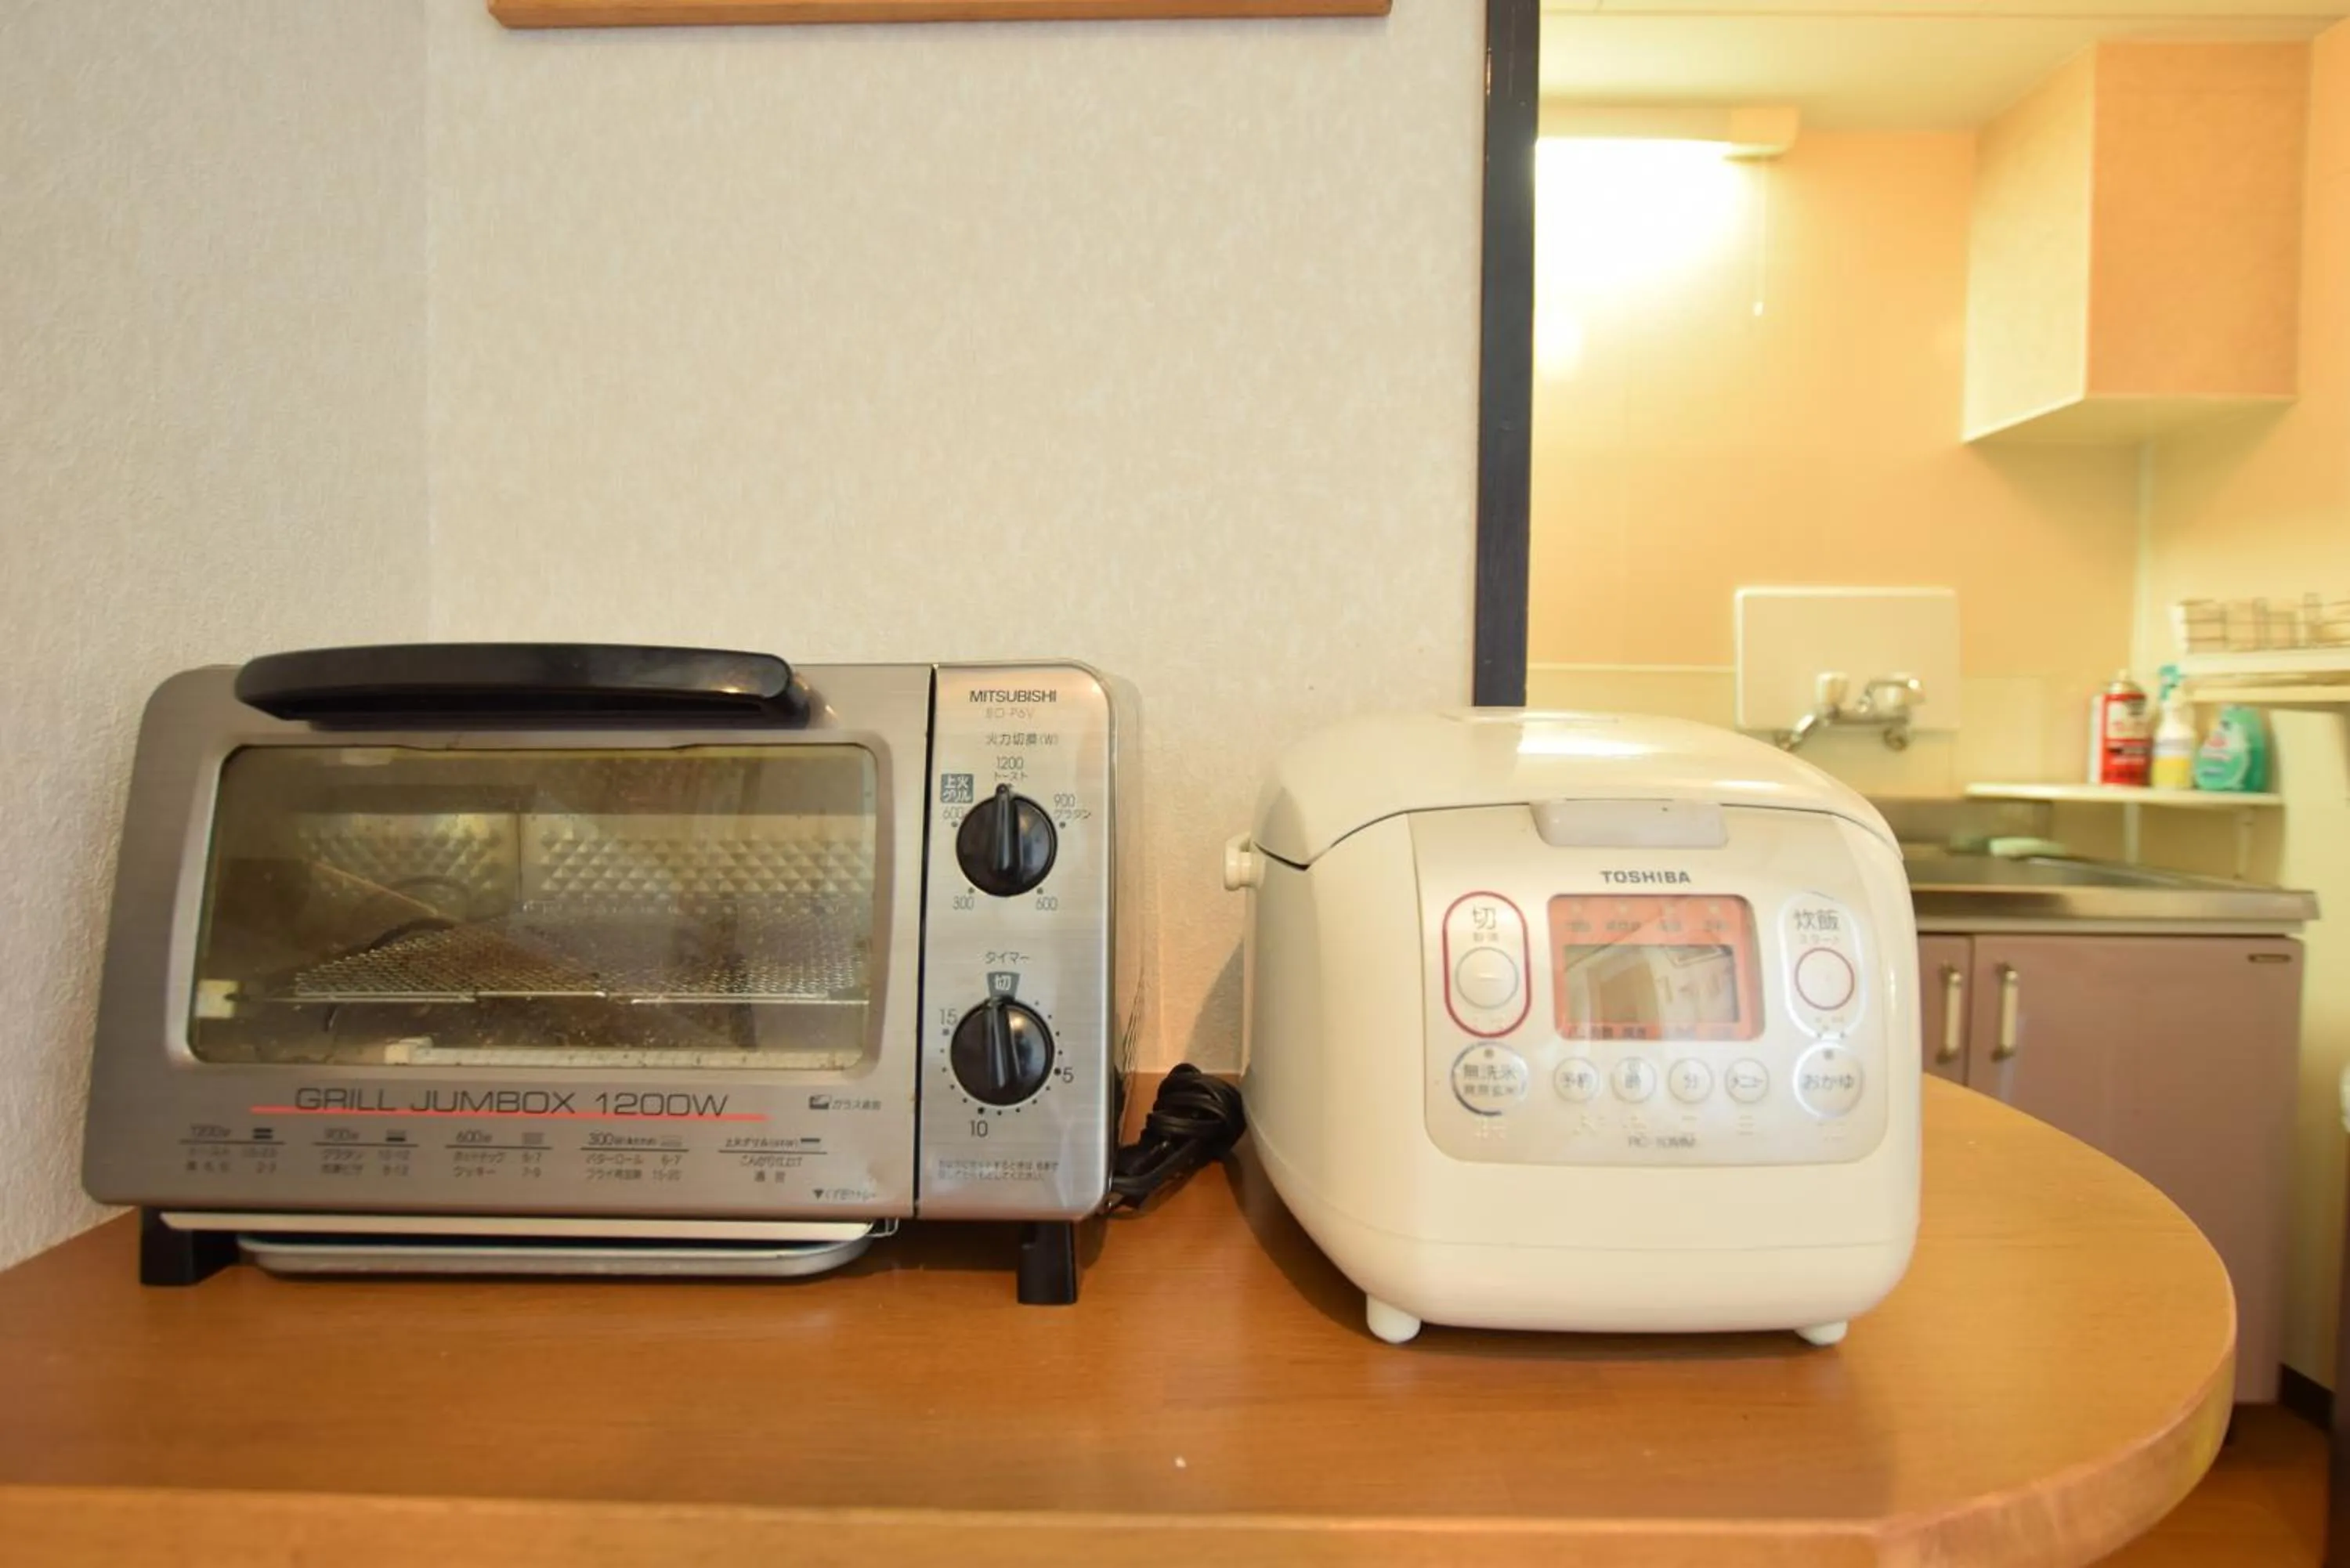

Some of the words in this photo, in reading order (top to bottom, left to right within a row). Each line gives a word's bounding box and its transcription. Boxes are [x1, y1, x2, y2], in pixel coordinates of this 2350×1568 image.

[968, 689, 1058, 703] MITSUBISHI
[996, 757, 1024, 770] 1200
[994, 773, 1029, 782] トースト
[1054, 794, 1076, 807] 900
[1599, 869, 1691, 885] TOSHIBA
[953, 898, 974, 911] 300
[1036, 898, 1058, 911] 600
[1473, 905, 1497, 930] 切
[1794, 909, 1840, 931] 炊飯
[985, 951, 1030, 964] タイマー
[939, 1008, 957, 1026] 15
[1062, 1068, 1074, 1083] 5
[1801, 1072, 1855, 1092] おかゆ
[295, 1087, 397, 1111] GRILL
[410, 1089, 576, 1115] JUMBOX
[595, 1093, 728, 1118] 1200W
[969, 1120, 989, 1137] 10
